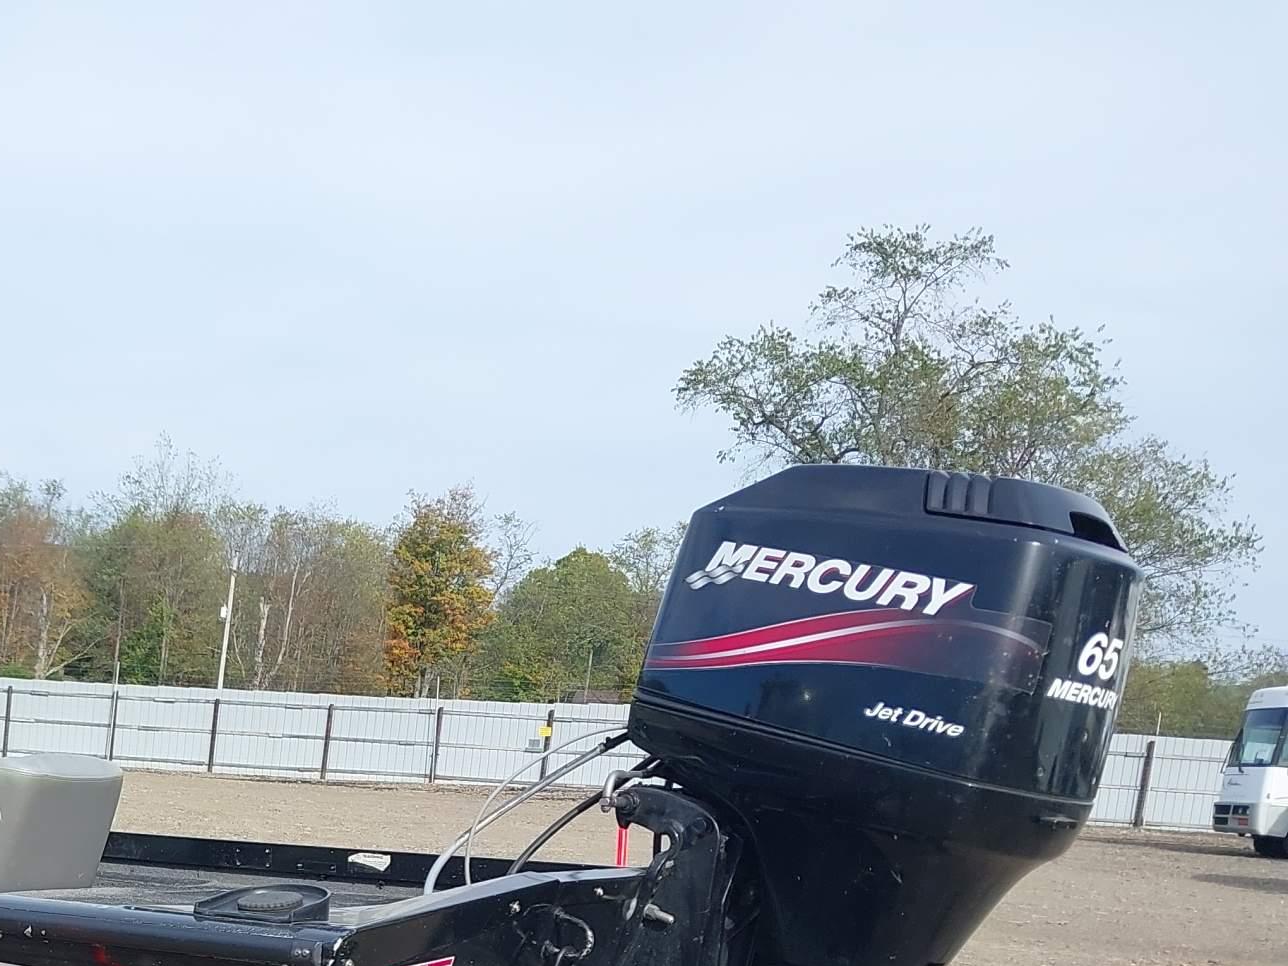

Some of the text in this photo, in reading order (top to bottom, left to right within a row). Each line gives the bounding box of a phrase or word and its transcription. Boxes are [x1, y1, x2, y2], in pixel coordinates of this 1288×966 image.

[705, 540, 974, 616] MERCURY
[1077, 631, 1124, 680] 65
[864, 702, 965, 736] Jet Drive
